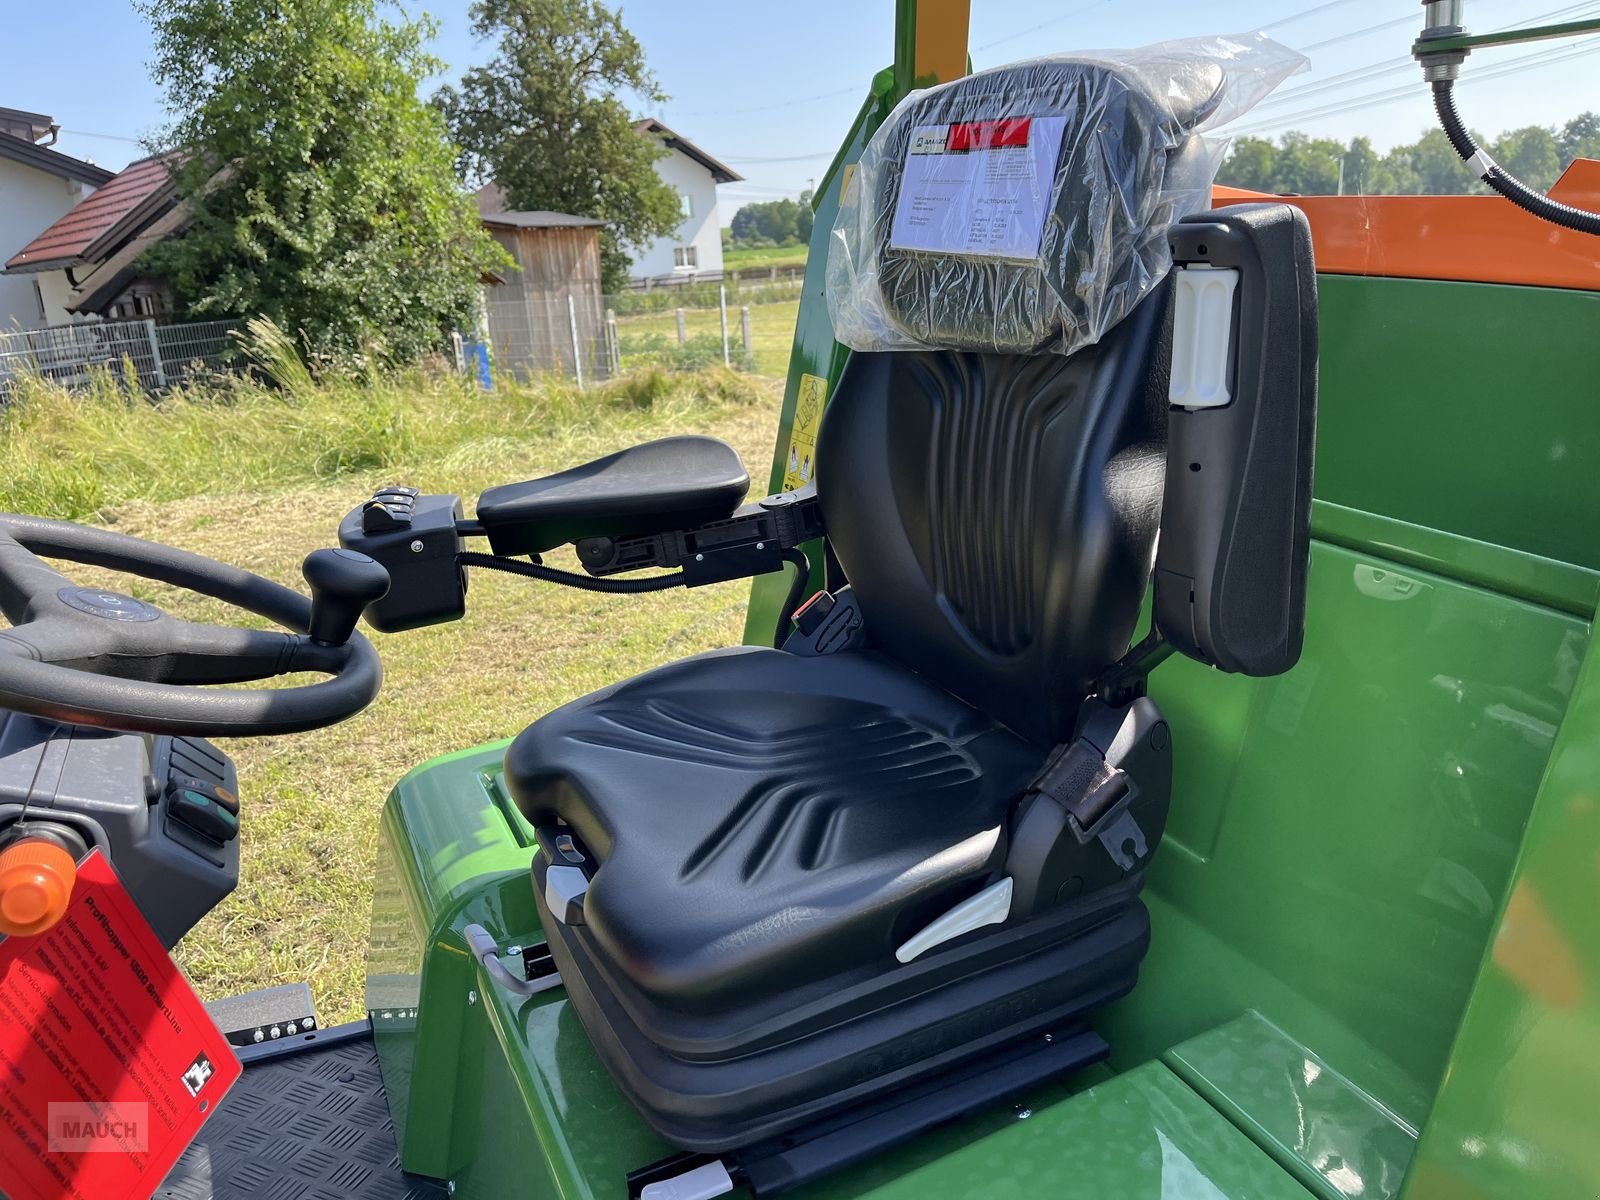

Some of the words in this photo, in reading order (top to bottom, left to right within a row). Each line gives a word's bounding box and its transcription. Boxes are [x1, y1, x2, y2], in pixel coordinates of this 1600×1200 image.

[84, 895, 131, 960] Profihopper
[128, 957, 149, 985] 1500
[145, 982, 182, 1034] SmartLine
